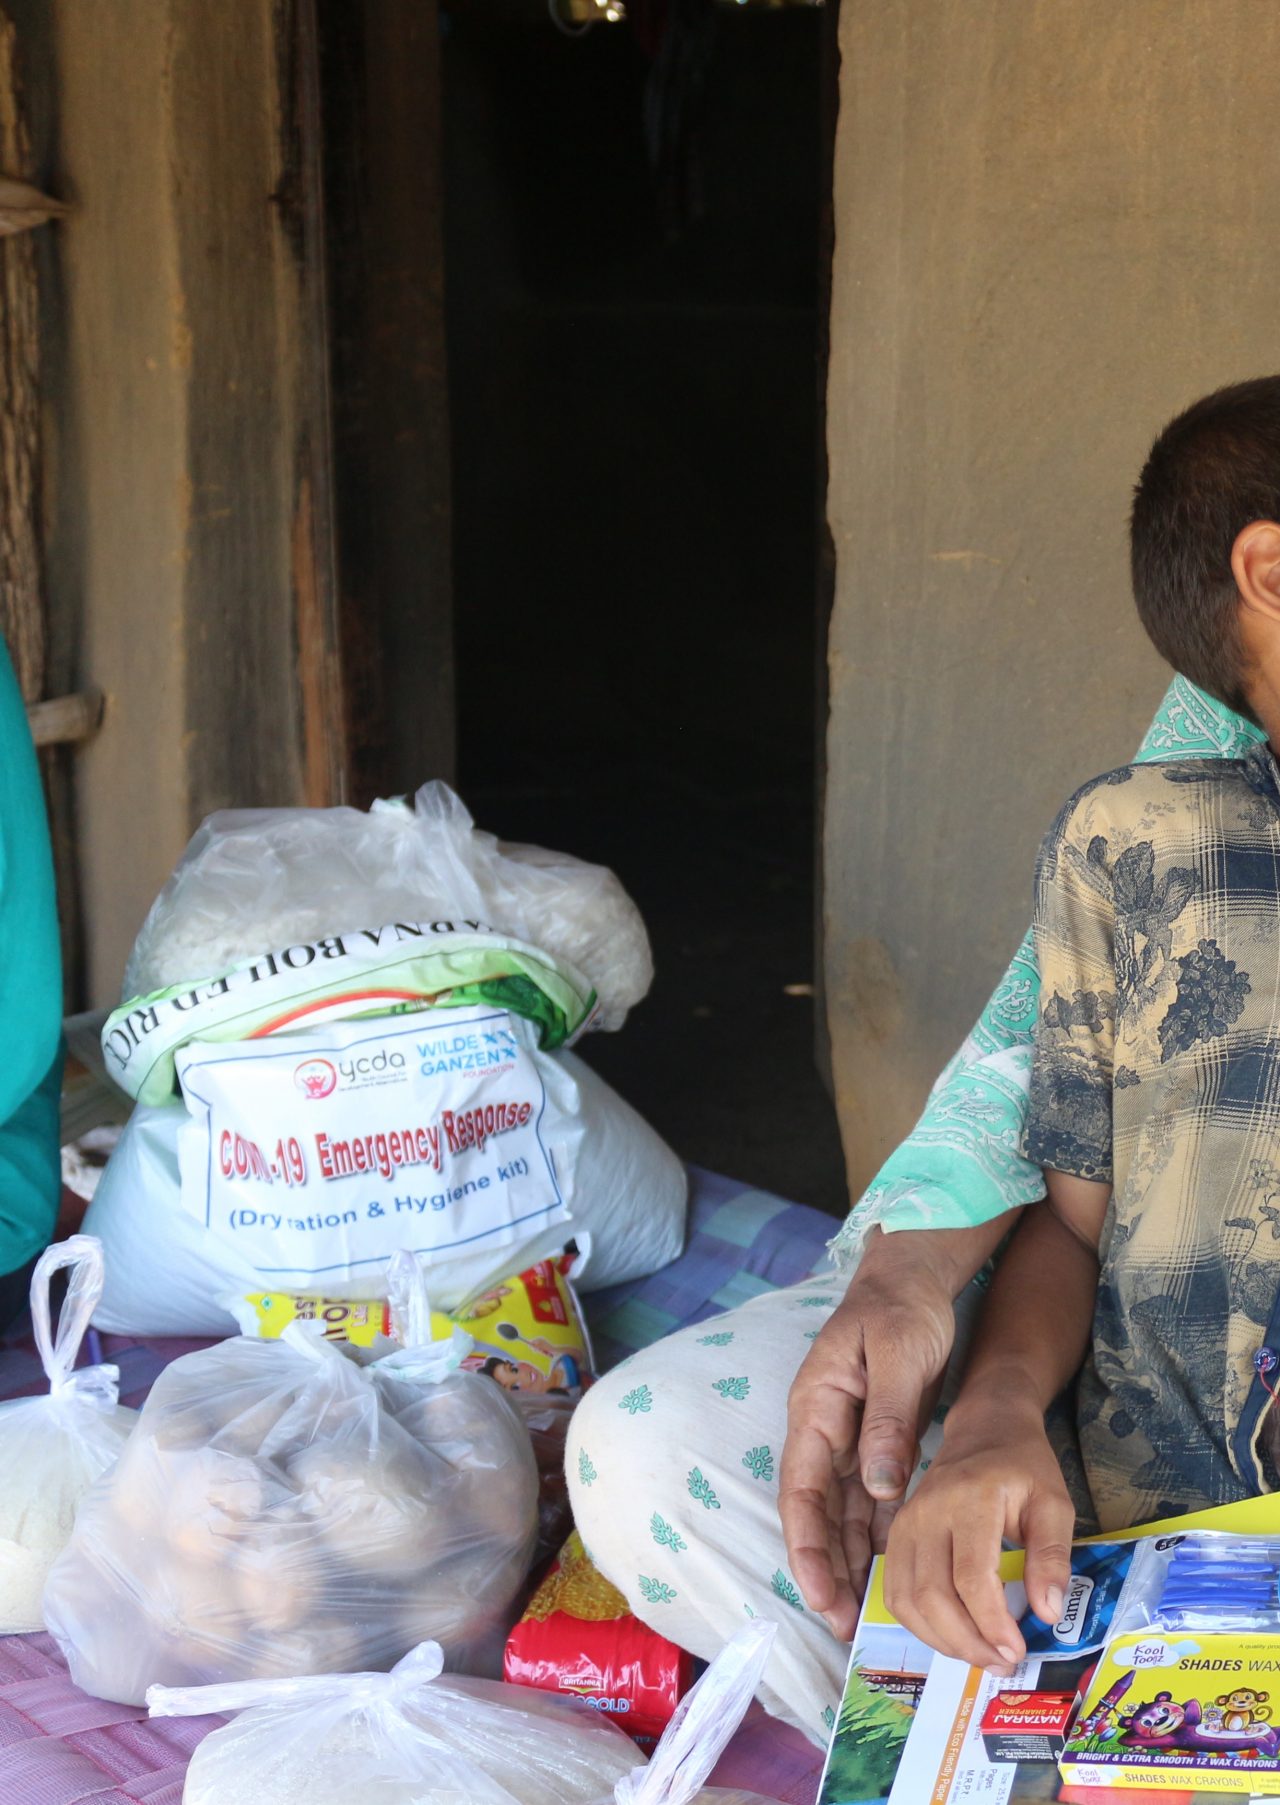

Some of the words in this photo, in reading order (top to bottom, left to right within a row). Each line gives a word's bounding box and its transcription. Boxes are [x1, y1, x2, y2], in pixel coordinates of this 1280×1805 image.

[416, 1036, 478, 1058] WILDE
[338, 1049, 406, 1082] ycda
[420, 1050, 500, 1076] GANZEN
[315, 1124, 440, 1178] Emergency
[442, 1101, 532, 1153] Response
[229, 1209, 282, 1231] (Dry
[367, 1201, 385, 1218] &
[394, 1176, 490, 1213] Hygiene
[498, 1158, 529, 1182] kit)
[1056, 1581, 1090, 1635] Camay
[1134, 1644, 1165, 1655] Kool
[1179, 1658, 1243, 1671] SHADES
[961, 1698, 974, 1716] Made
[993, 1714, 1062, 1724] NATARAJ
[952, 1733, 963, 1747] Eco
[941, 1748, 959, 1777] Friendly
[1076, 1753, 1111, 1761] BRIGHT
[1121, 1754, 1152, 1763] EXTRA
[1153, 1755, 1195, 1764] SMOOTH
[1196, 1757, 1207, 1765] 12
[1209, 1758, 1231, 1767] WAX
[1233, 1760, 1278, 1768] CRAYONS
[936, 1778, 950, 1801] Paper
[1124, 1773, 1166, 1784] SHADES
[1168, 1776, 1193, 1784] WAX
[1195, 1776, 1244, 1788] CRAYONS
